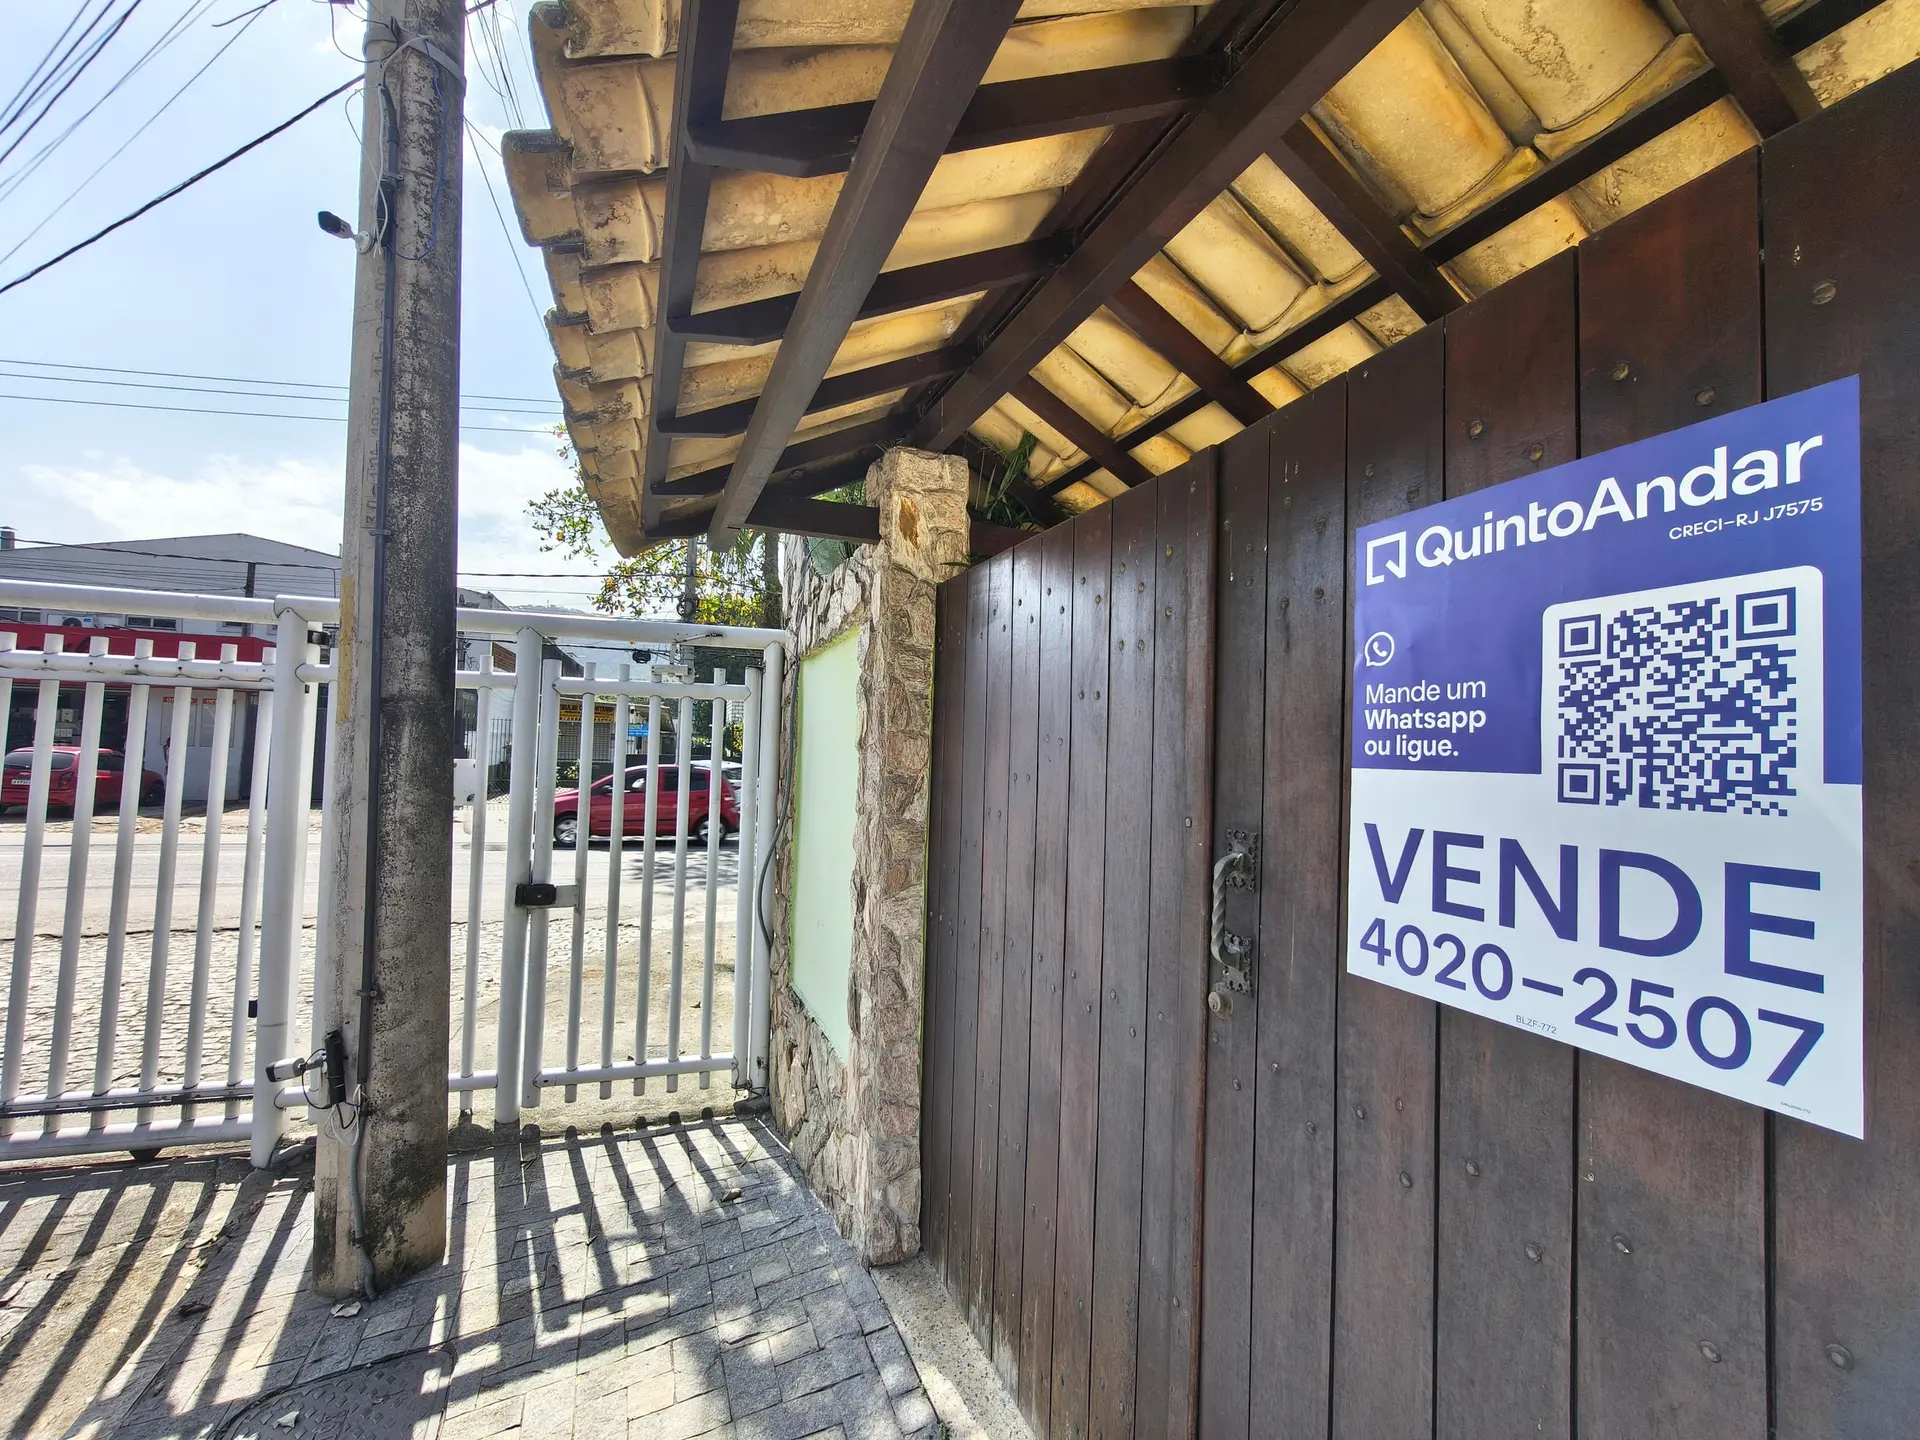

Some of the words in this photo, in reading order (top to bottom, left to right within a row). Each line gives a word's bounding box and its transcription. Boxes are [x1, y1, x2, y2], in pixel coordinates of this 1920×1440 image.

[1415, 434, 1823, 568] QuintoAndar
[1668, 510, 1759, 540] CRECI-RJ
[1763, 497, 1823, 521] J7575
[1365, 680, 1440, 705] Mande
[1447, 680, 1486, 700] um
[1364, 708, 1487, 734] Whatsapp
[1364, 739, 1391, 756] ou
[1396, 734, 1459, 762] ligue.
[1364, 822, 1825, 994] VENDE
[1360, 917, 1825, 1087] 4020-2507
[1515, 1014, 1557, 1034] BLZF-772
